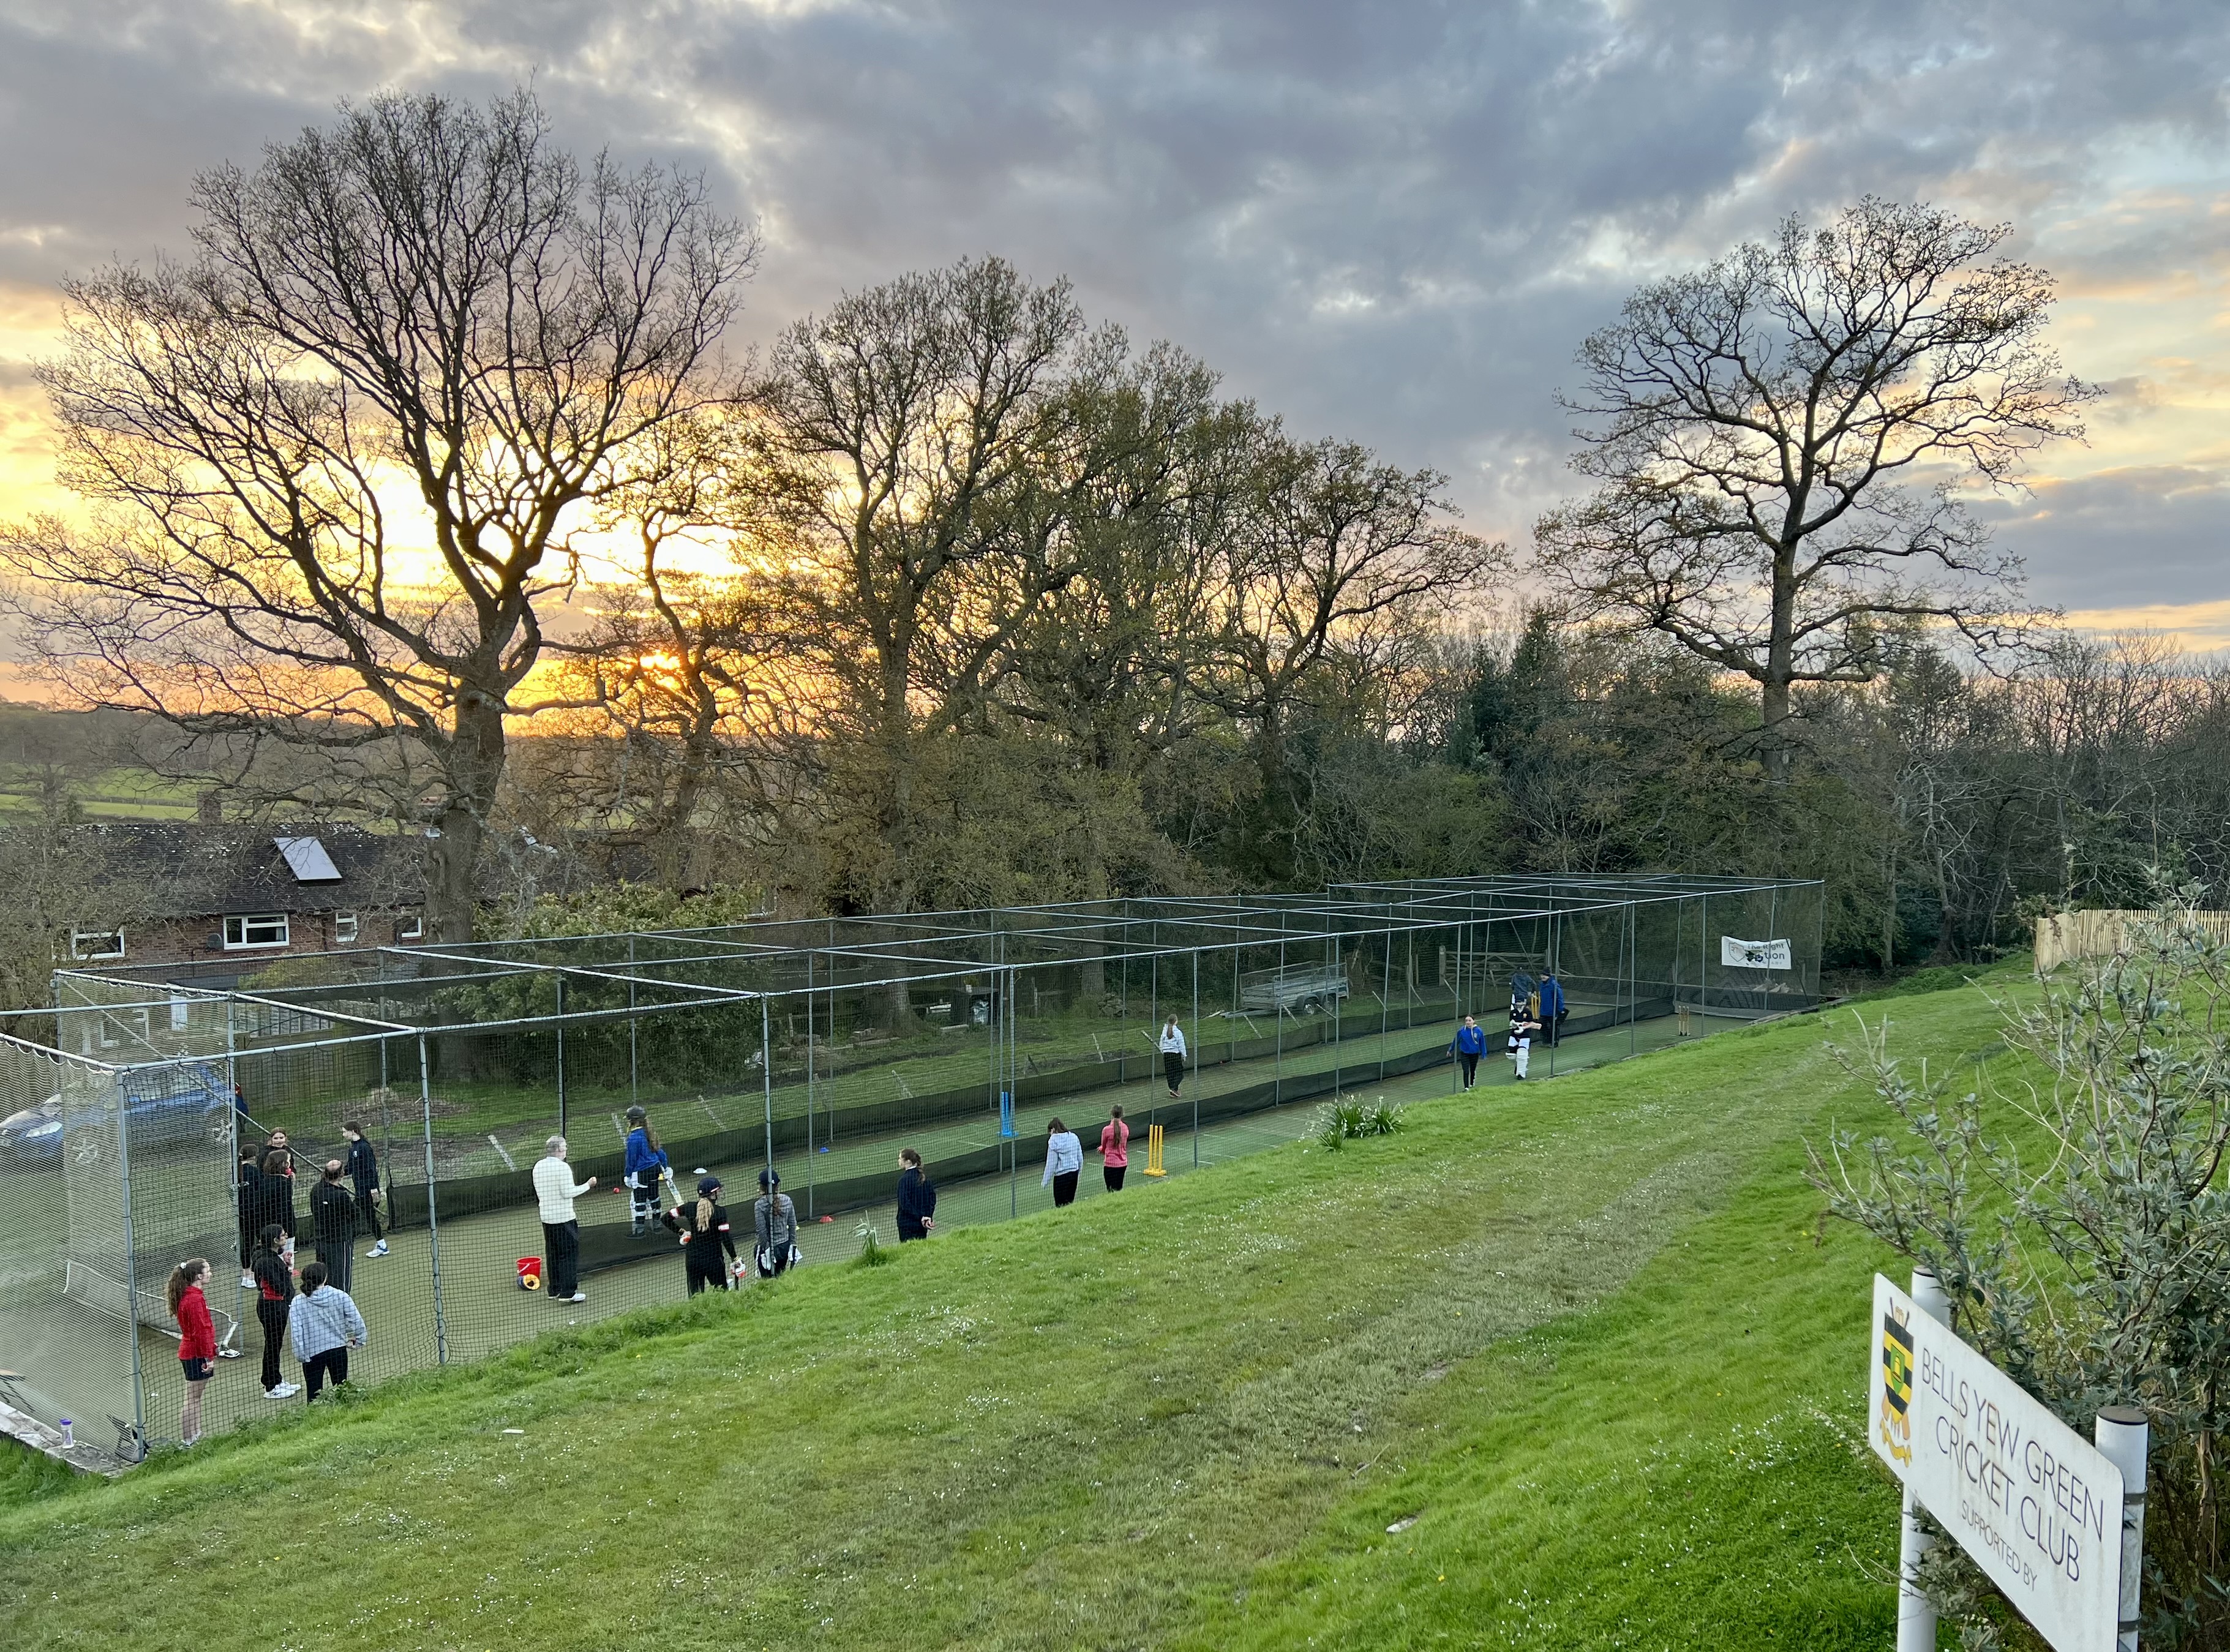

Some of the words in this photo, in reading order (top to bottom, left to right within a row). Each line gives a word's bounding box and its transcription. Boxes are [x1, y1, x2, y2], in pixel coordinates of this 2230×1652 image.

[1922, 1347, 1969, 1419] BELLS
[1973, 1389, 2019, 1462] YEW
[2025, 1440, 2103, 1542] GREEN
[1936, 1415, 2015, 1515] CRICKET
[2021, 1495, 2079, 1582] CLUB
[1962, 1500, 2021, 1574] SUPPORTED
[2023, 1562, 2038, 1591] BY
